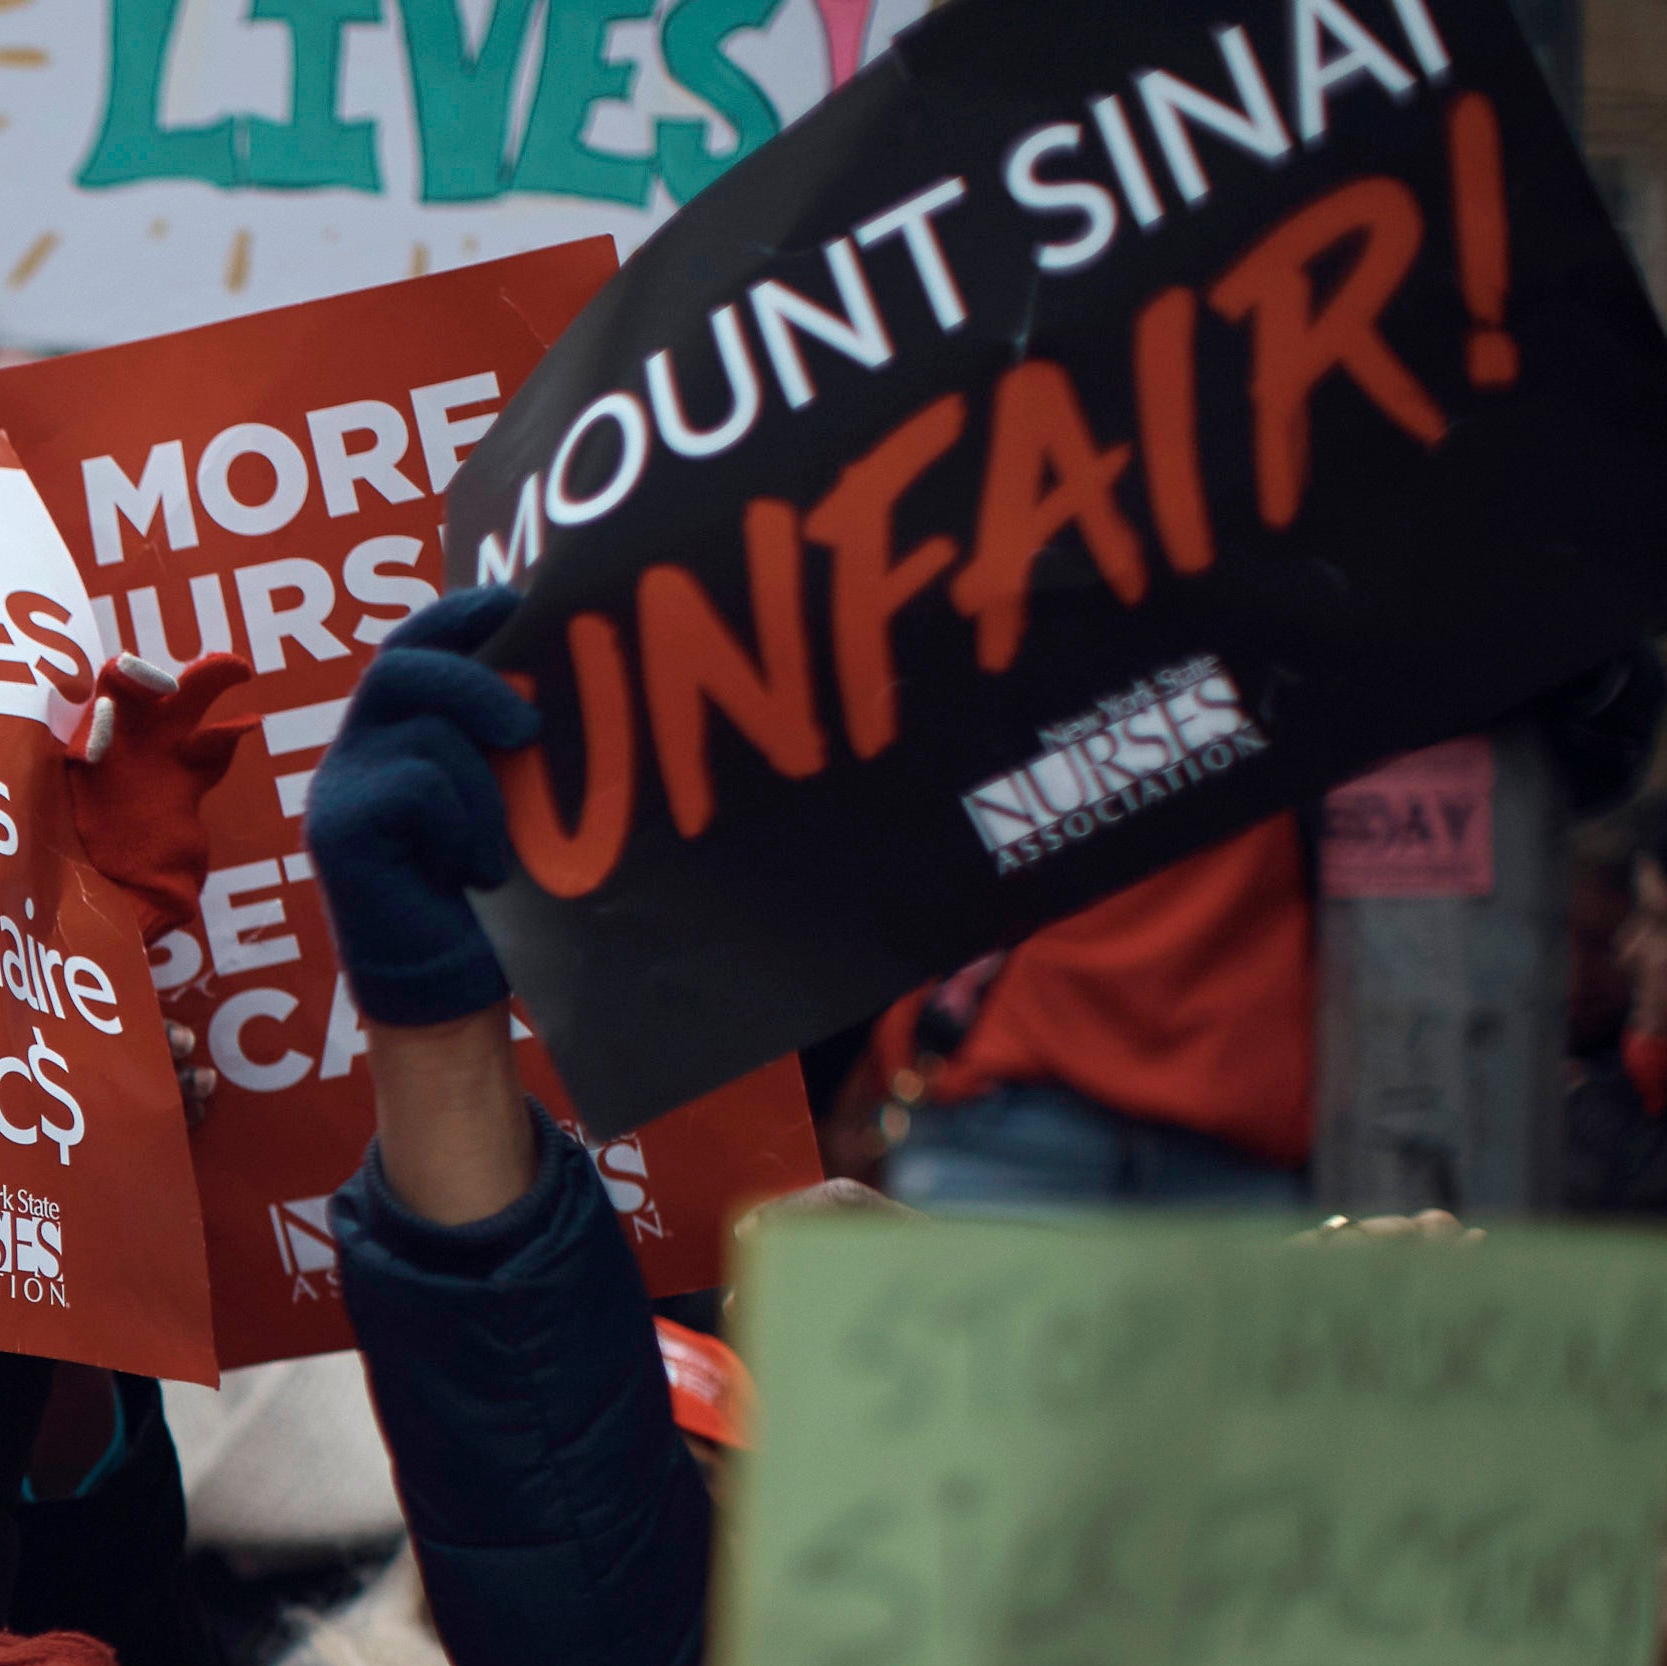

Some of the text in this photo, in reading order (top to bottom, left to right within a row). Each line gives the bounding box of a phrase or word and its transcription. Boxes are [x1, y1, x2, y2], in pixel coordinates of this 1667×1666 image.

[477, 0, 1454, 589] MOUNT SINAI
[80, 371, 501, 567] MORE
[489, 91, 1520, 901] UNFAIR!
[962, 676, 1242, 852] NURSES
[997, 720, 1268, 876] ASSOCIATION
[18, 1189, 60, 1220] State
